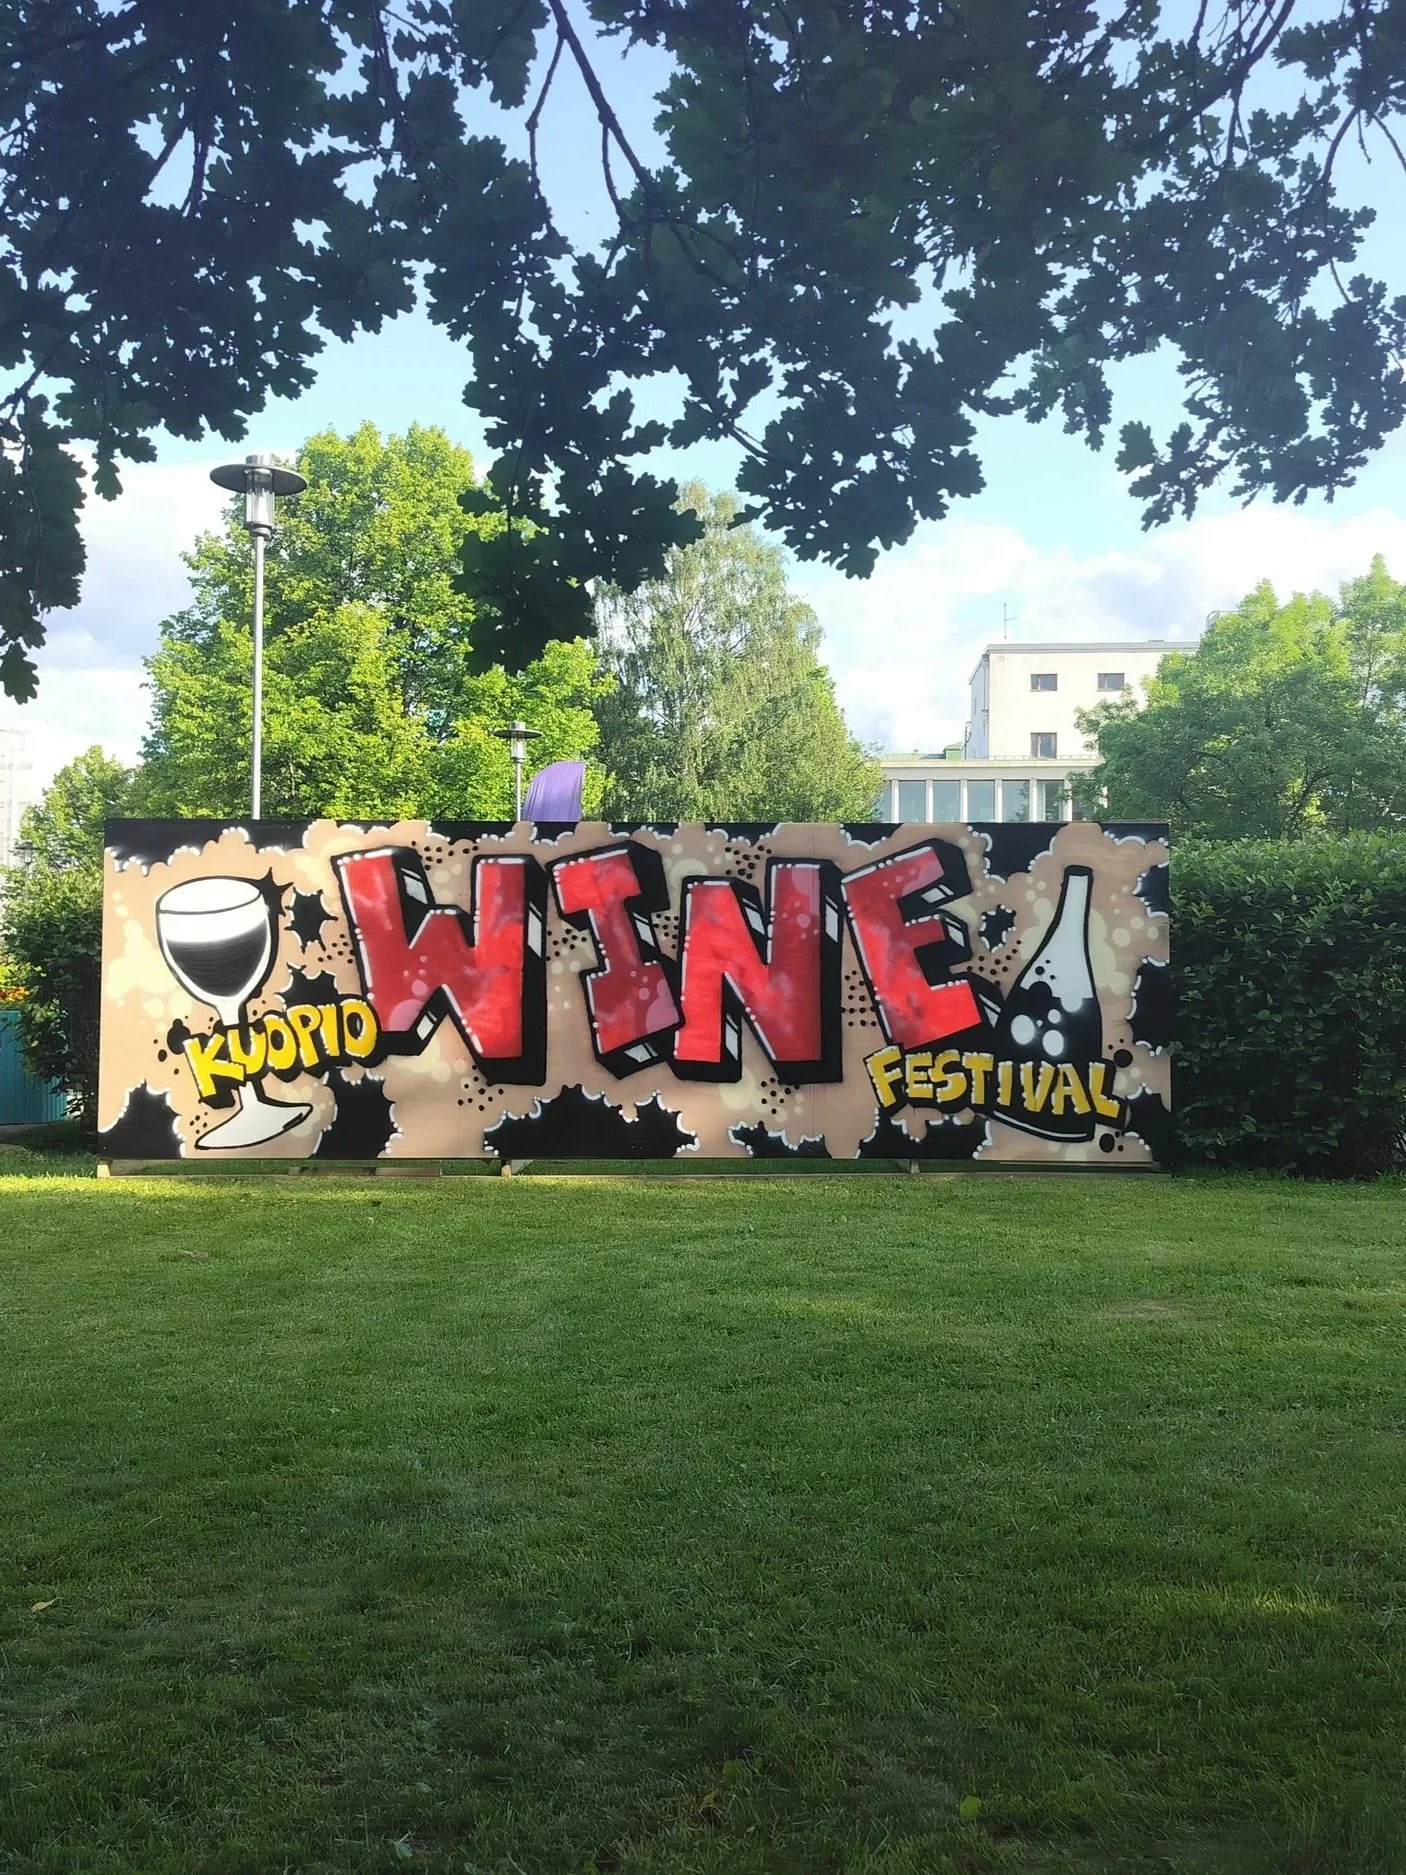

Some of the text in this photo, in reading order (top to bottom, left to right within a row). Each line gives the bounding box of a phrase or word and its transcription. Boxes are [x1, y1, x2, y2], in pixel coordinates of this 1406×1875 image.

[334, 843, 986, 1067] WINE
[183, 999, 381, 1098] KUOPIO
[865, 1045, 1121, 1118] FESTIVAL
